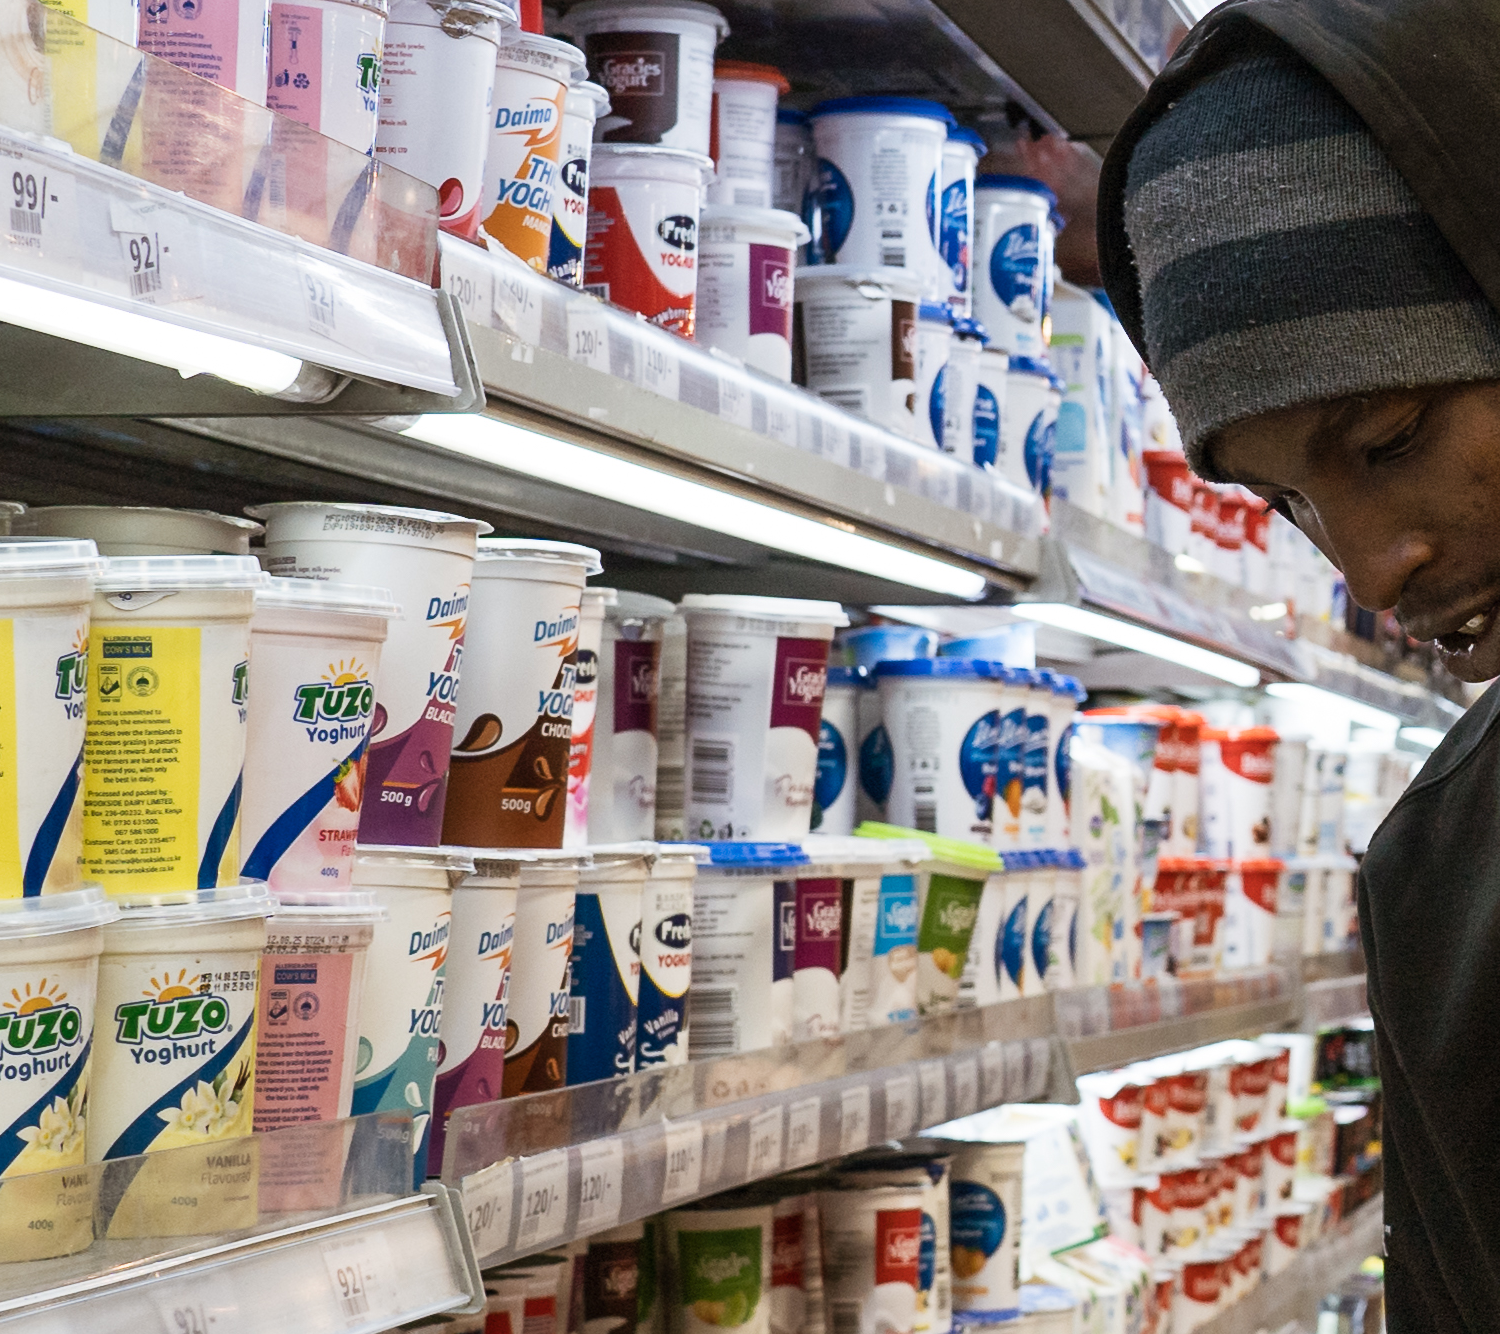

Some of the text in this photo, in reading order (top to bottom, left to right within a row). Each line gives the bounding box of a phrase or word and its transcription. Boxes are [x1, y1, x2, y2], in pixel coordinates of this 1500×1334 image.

[495, 104, 553, 129] Daima
[10, 169, 60, 219] 99/-
[306, 723, 366, 745] Yoghurt
[501, 798, 532, 813] 500g
[113, 994, 231, 1047] TUZO
[130, 1036, 219, 1067] Yoghurt
